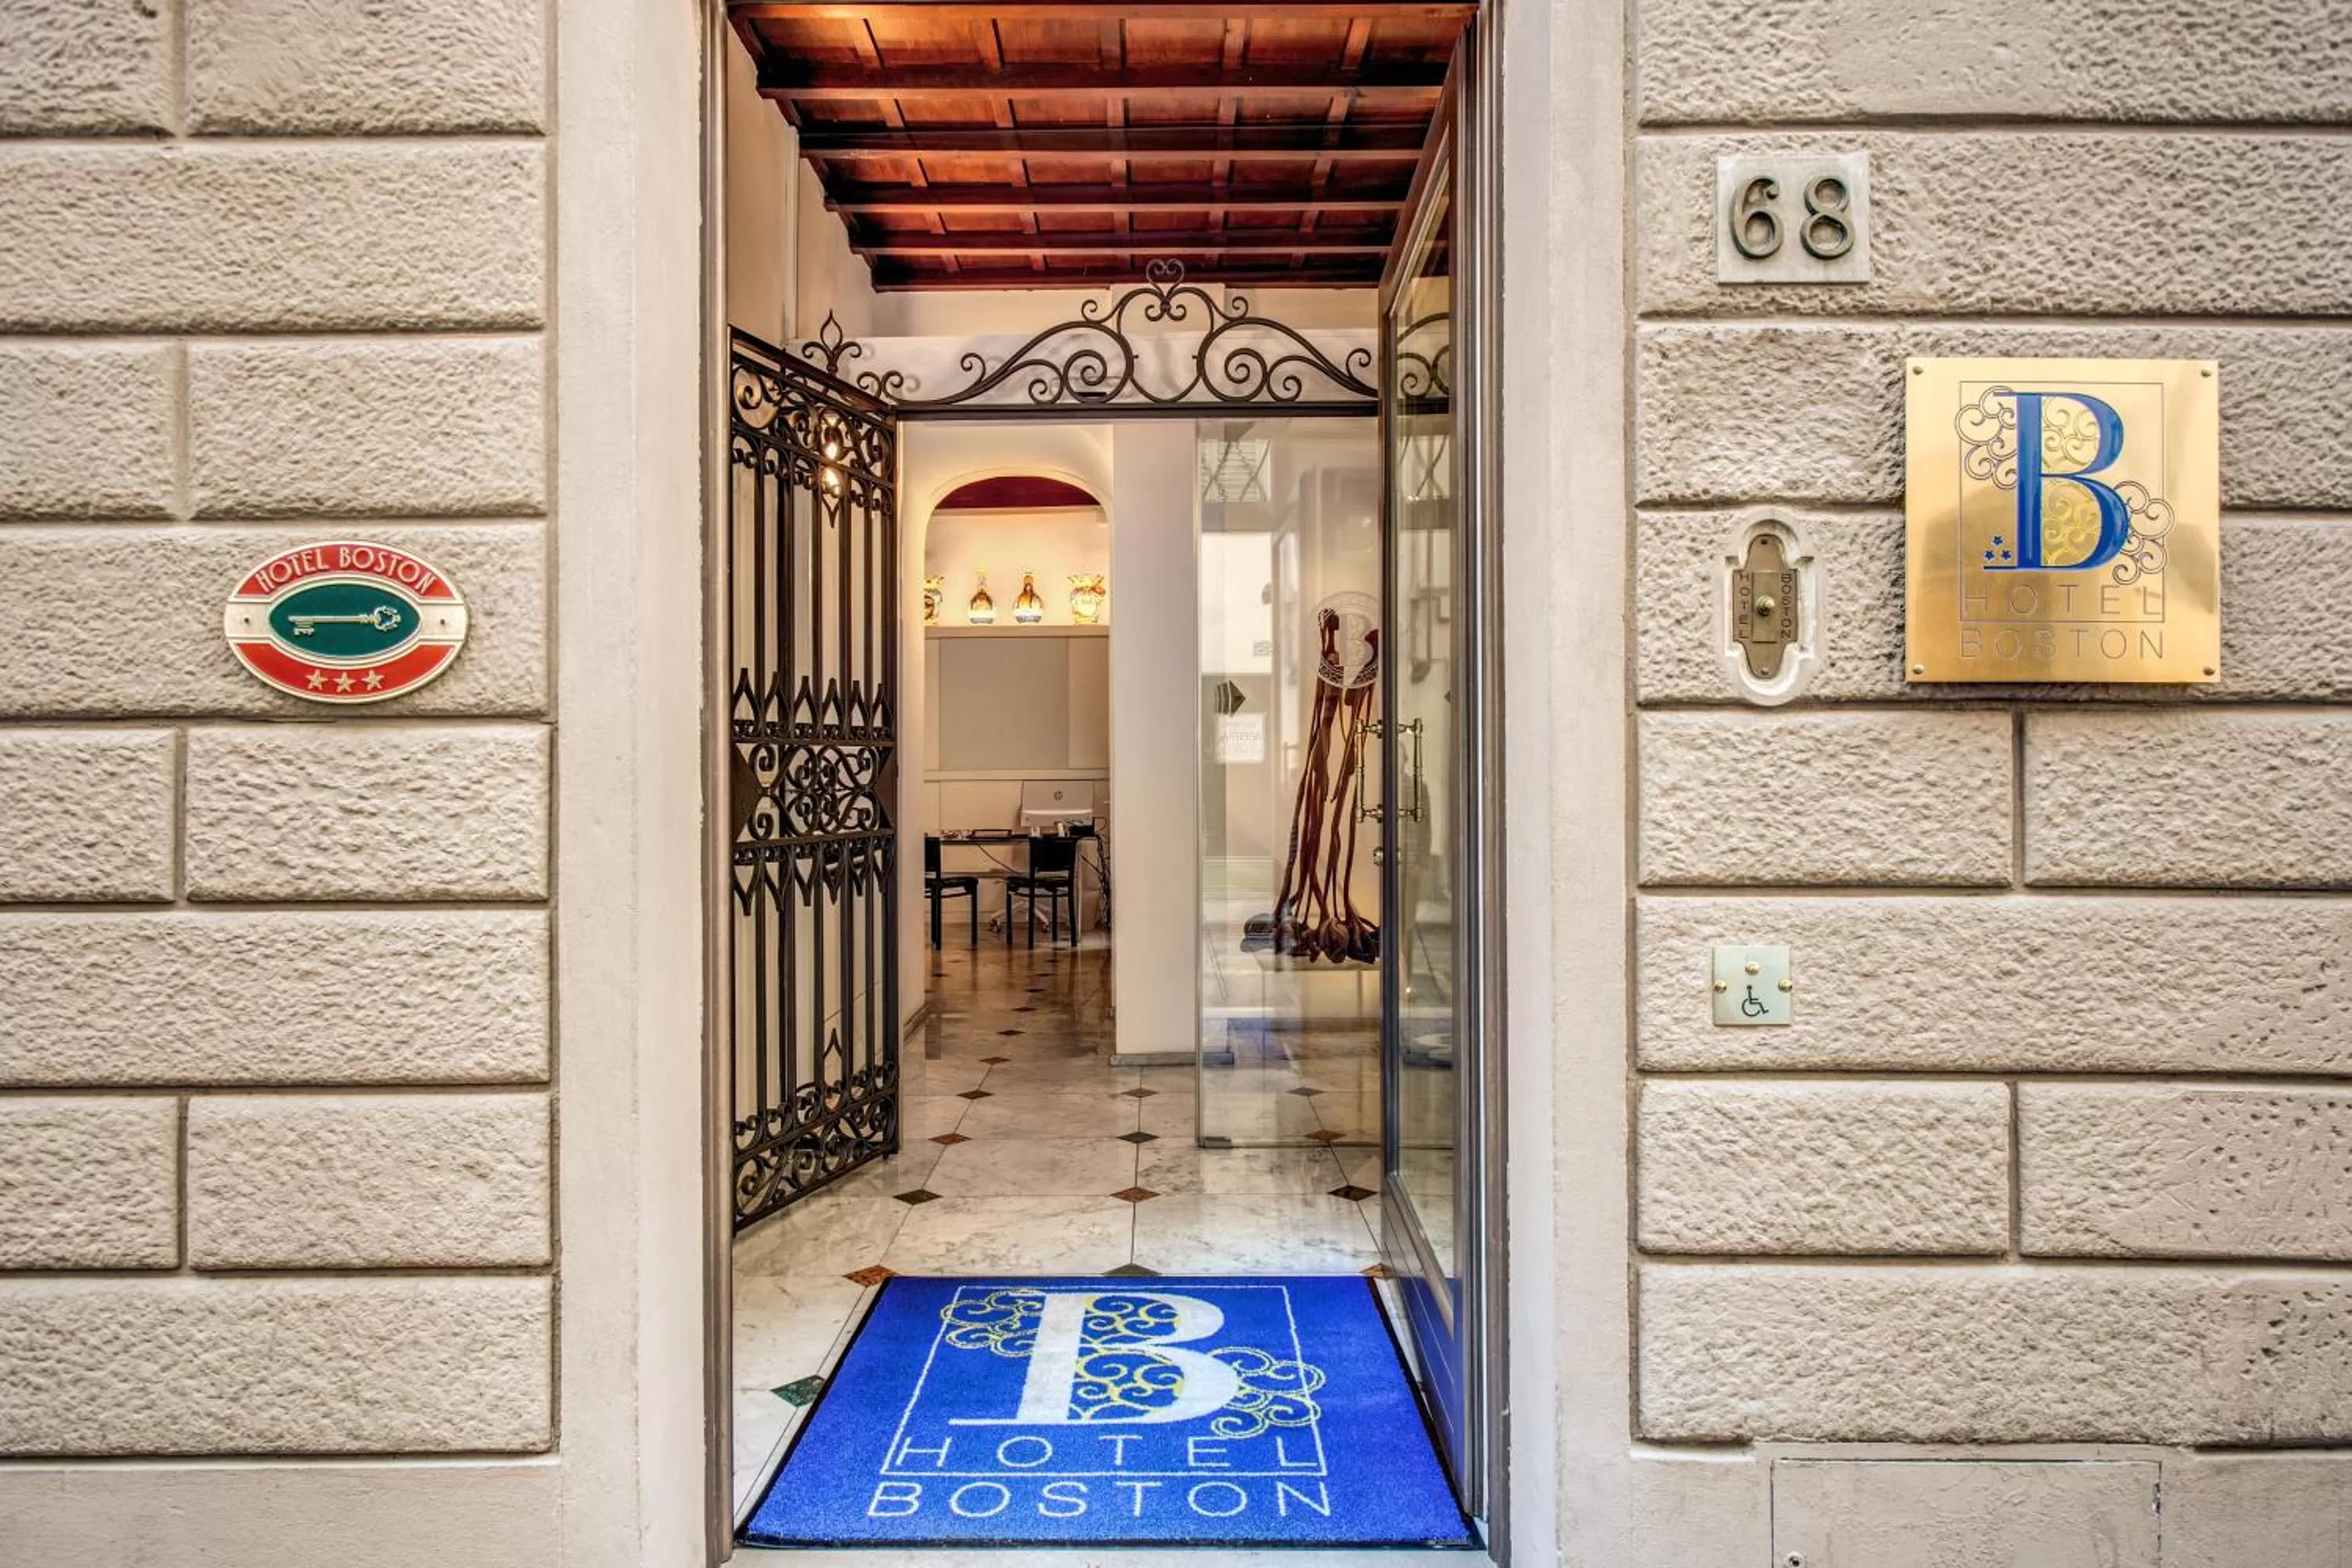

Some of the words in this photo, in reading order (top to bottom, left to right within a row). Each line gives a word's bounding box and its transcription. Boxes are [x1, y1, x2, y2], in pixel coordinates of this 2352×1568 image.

[1729, 176, 1855, 261] 68
[1983, 391, 2131, 572] B
[255, 547, 330, 593] HOTEL
[339, 546, 437, 593] BOSTON
[1738, 573, 1751, 639] HOTEL
[1780, 573, 1792, 639] BOSTON
[1962, 583, 2161, 615] HOTEL
[1960, 629, 2164, 660] BOSTON
[949, 1291, 1240, 1425] B
[895, 1435, 1319, 1468] HOTEL
[867, 1482, 1331, 1518] BOSTON
